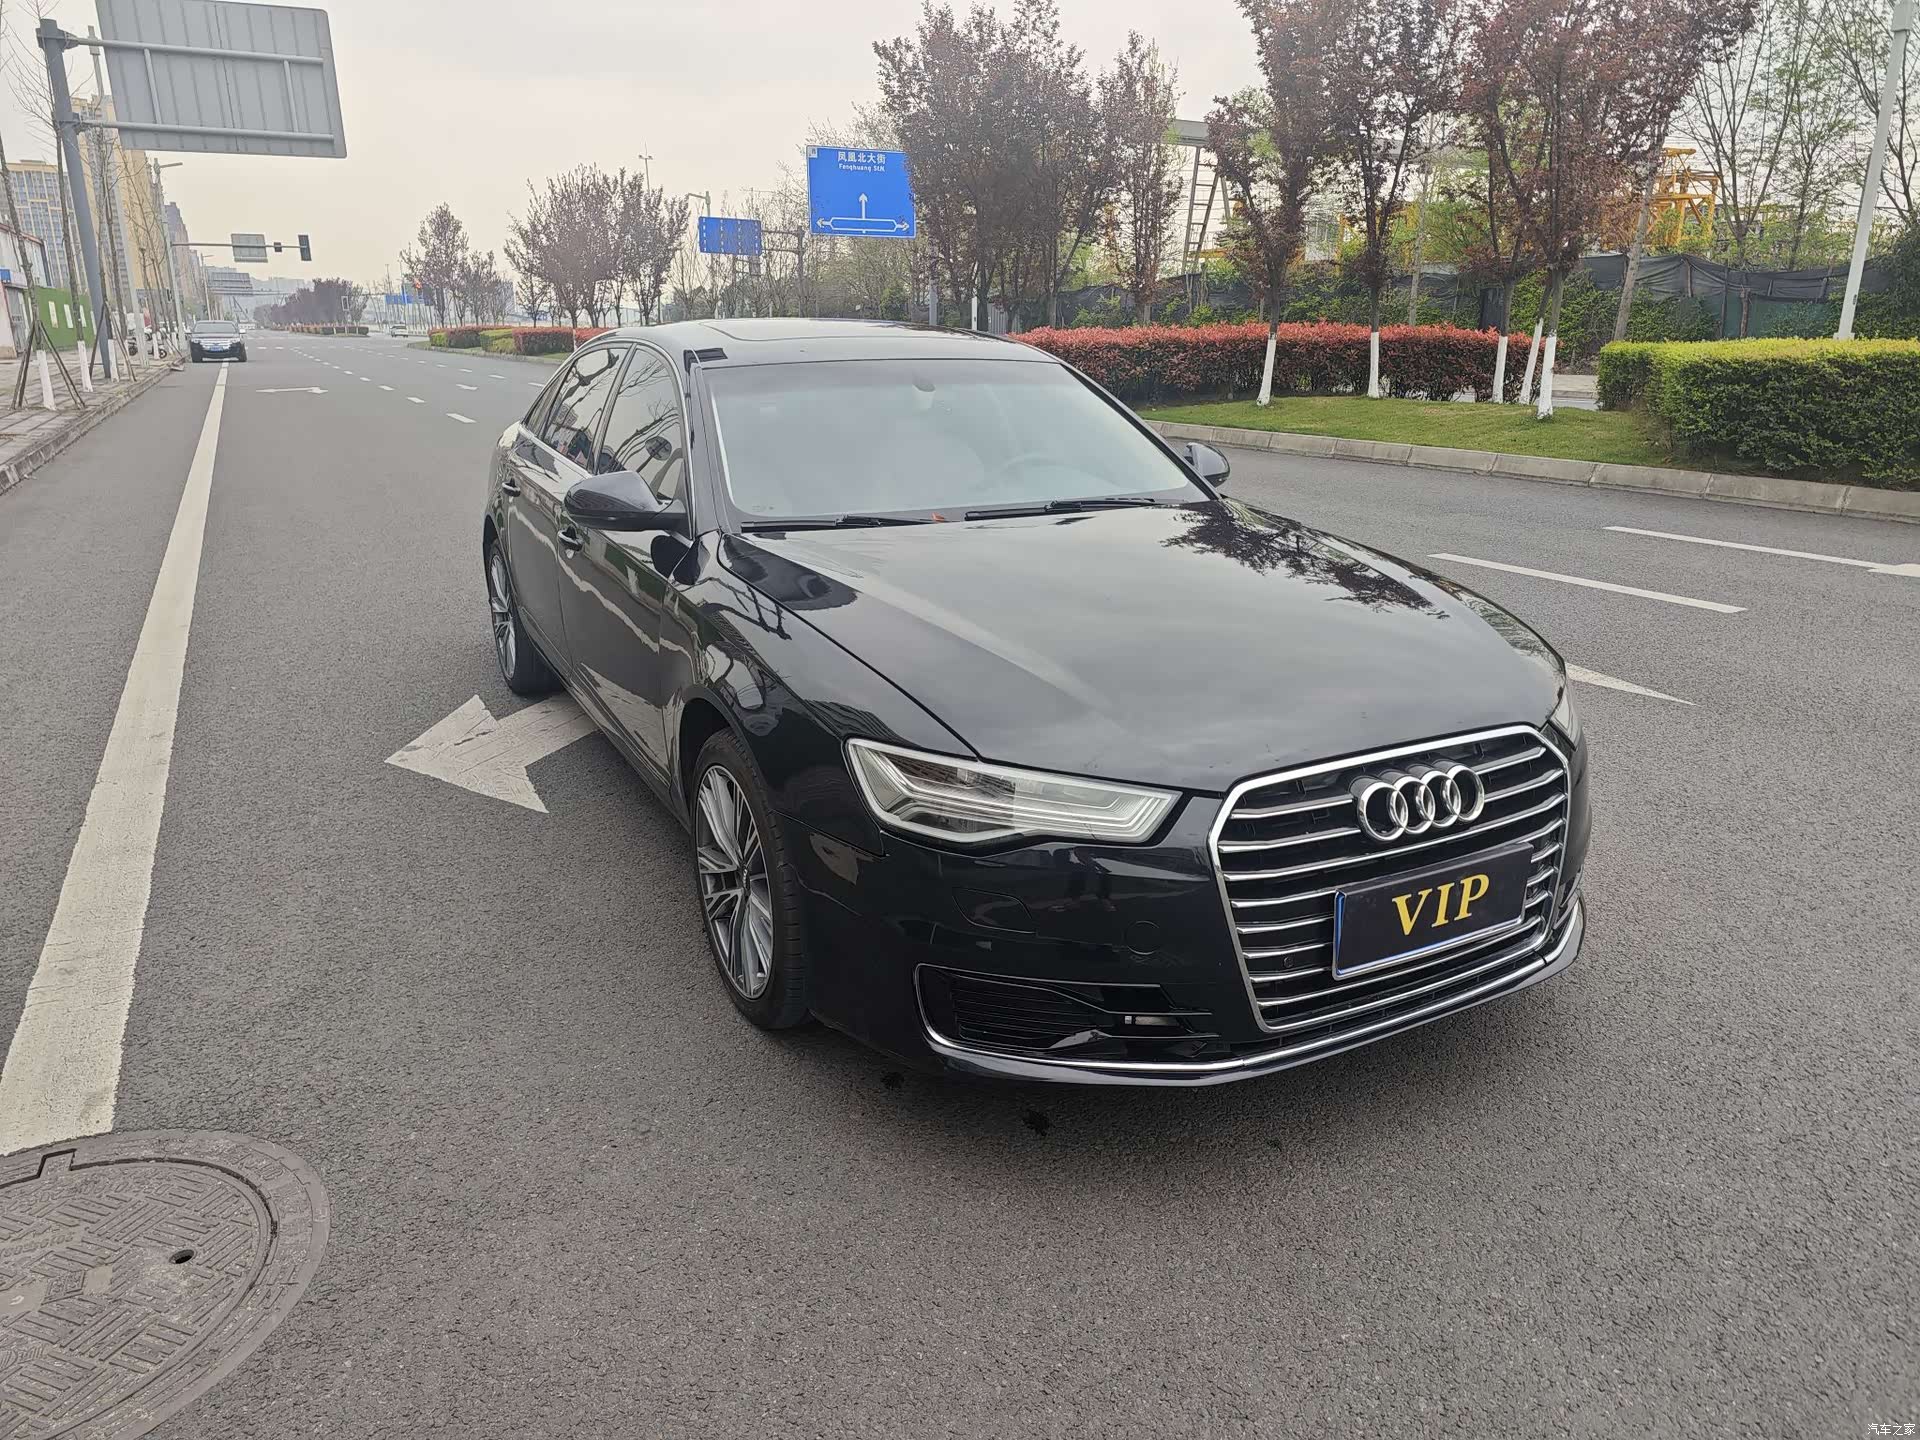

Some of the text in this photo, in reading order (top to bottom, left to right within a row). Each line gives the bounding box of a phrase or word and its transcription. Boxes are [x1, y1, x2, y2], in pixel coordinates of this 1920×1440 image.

[838, 151, 886, 164] 凤凰北大街
[1391, 873, 1490, 936] VIP
